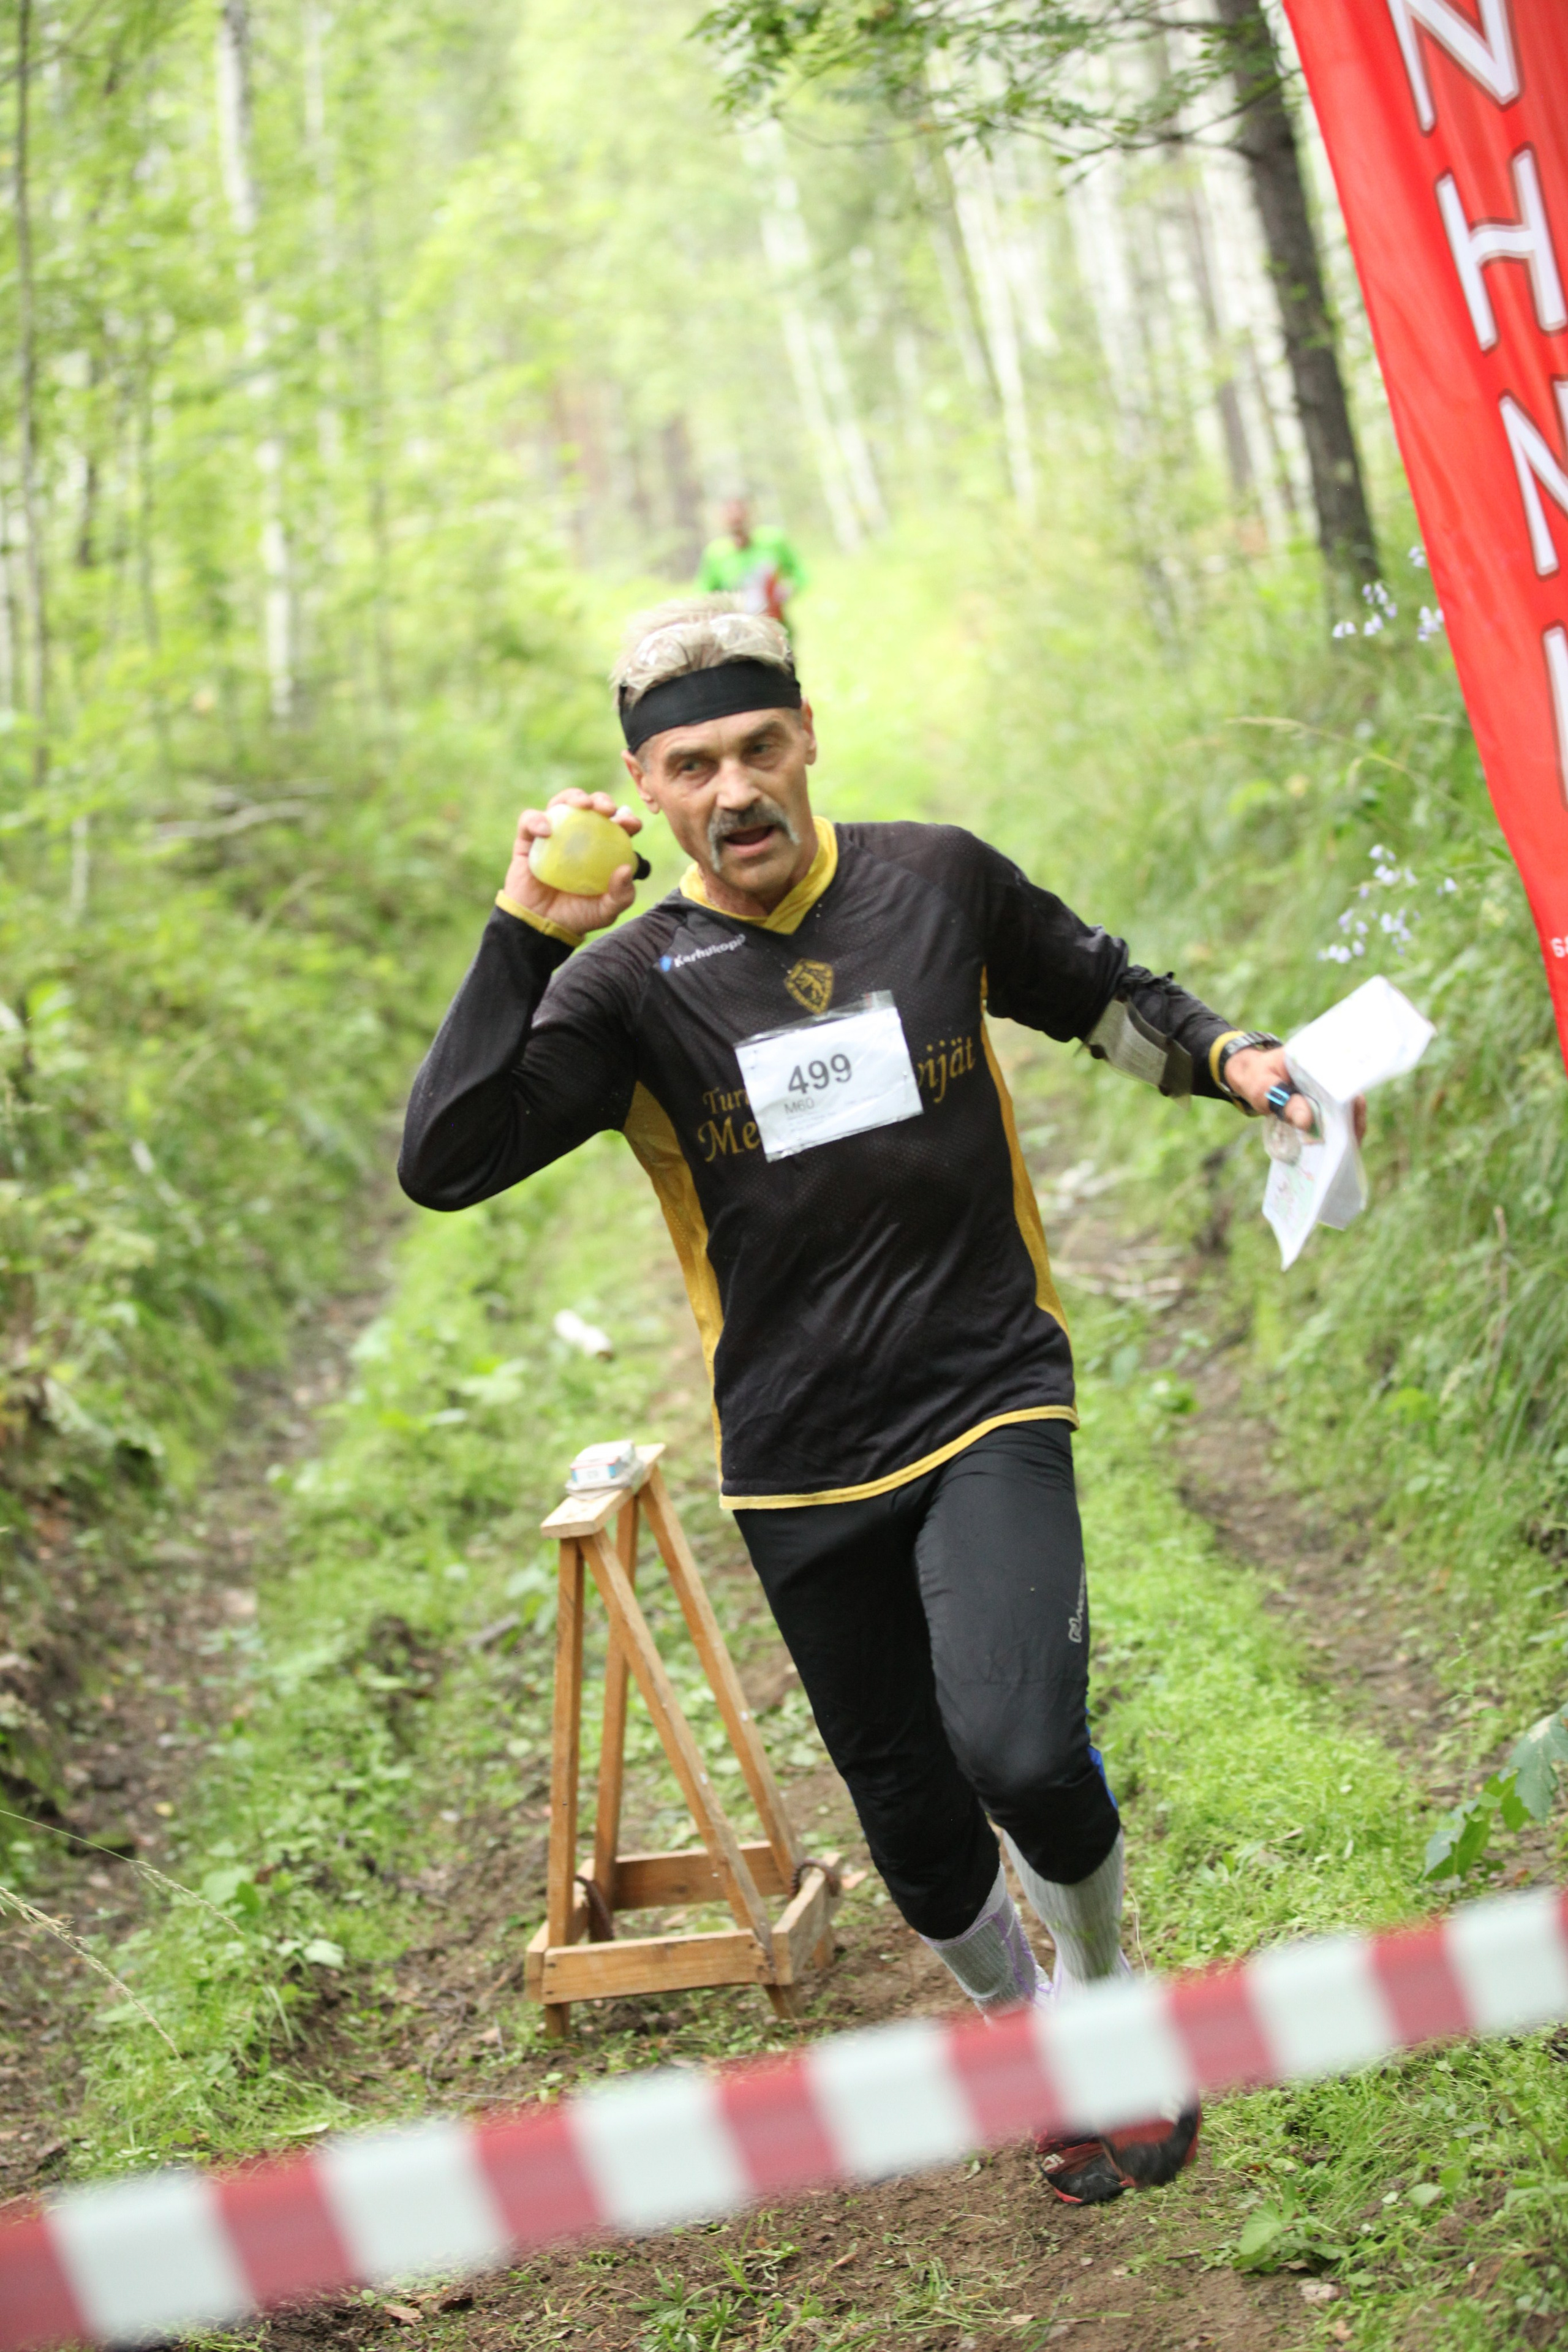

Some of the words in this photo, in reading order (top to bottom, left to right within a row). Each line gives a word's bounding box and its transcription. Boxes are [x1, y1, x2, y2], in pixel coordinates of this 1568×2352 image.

[788, 1054, 853, 1094] 499
[703, 1087, 750, 1115] Tur
[783, 1097, 815, 1114] M60
